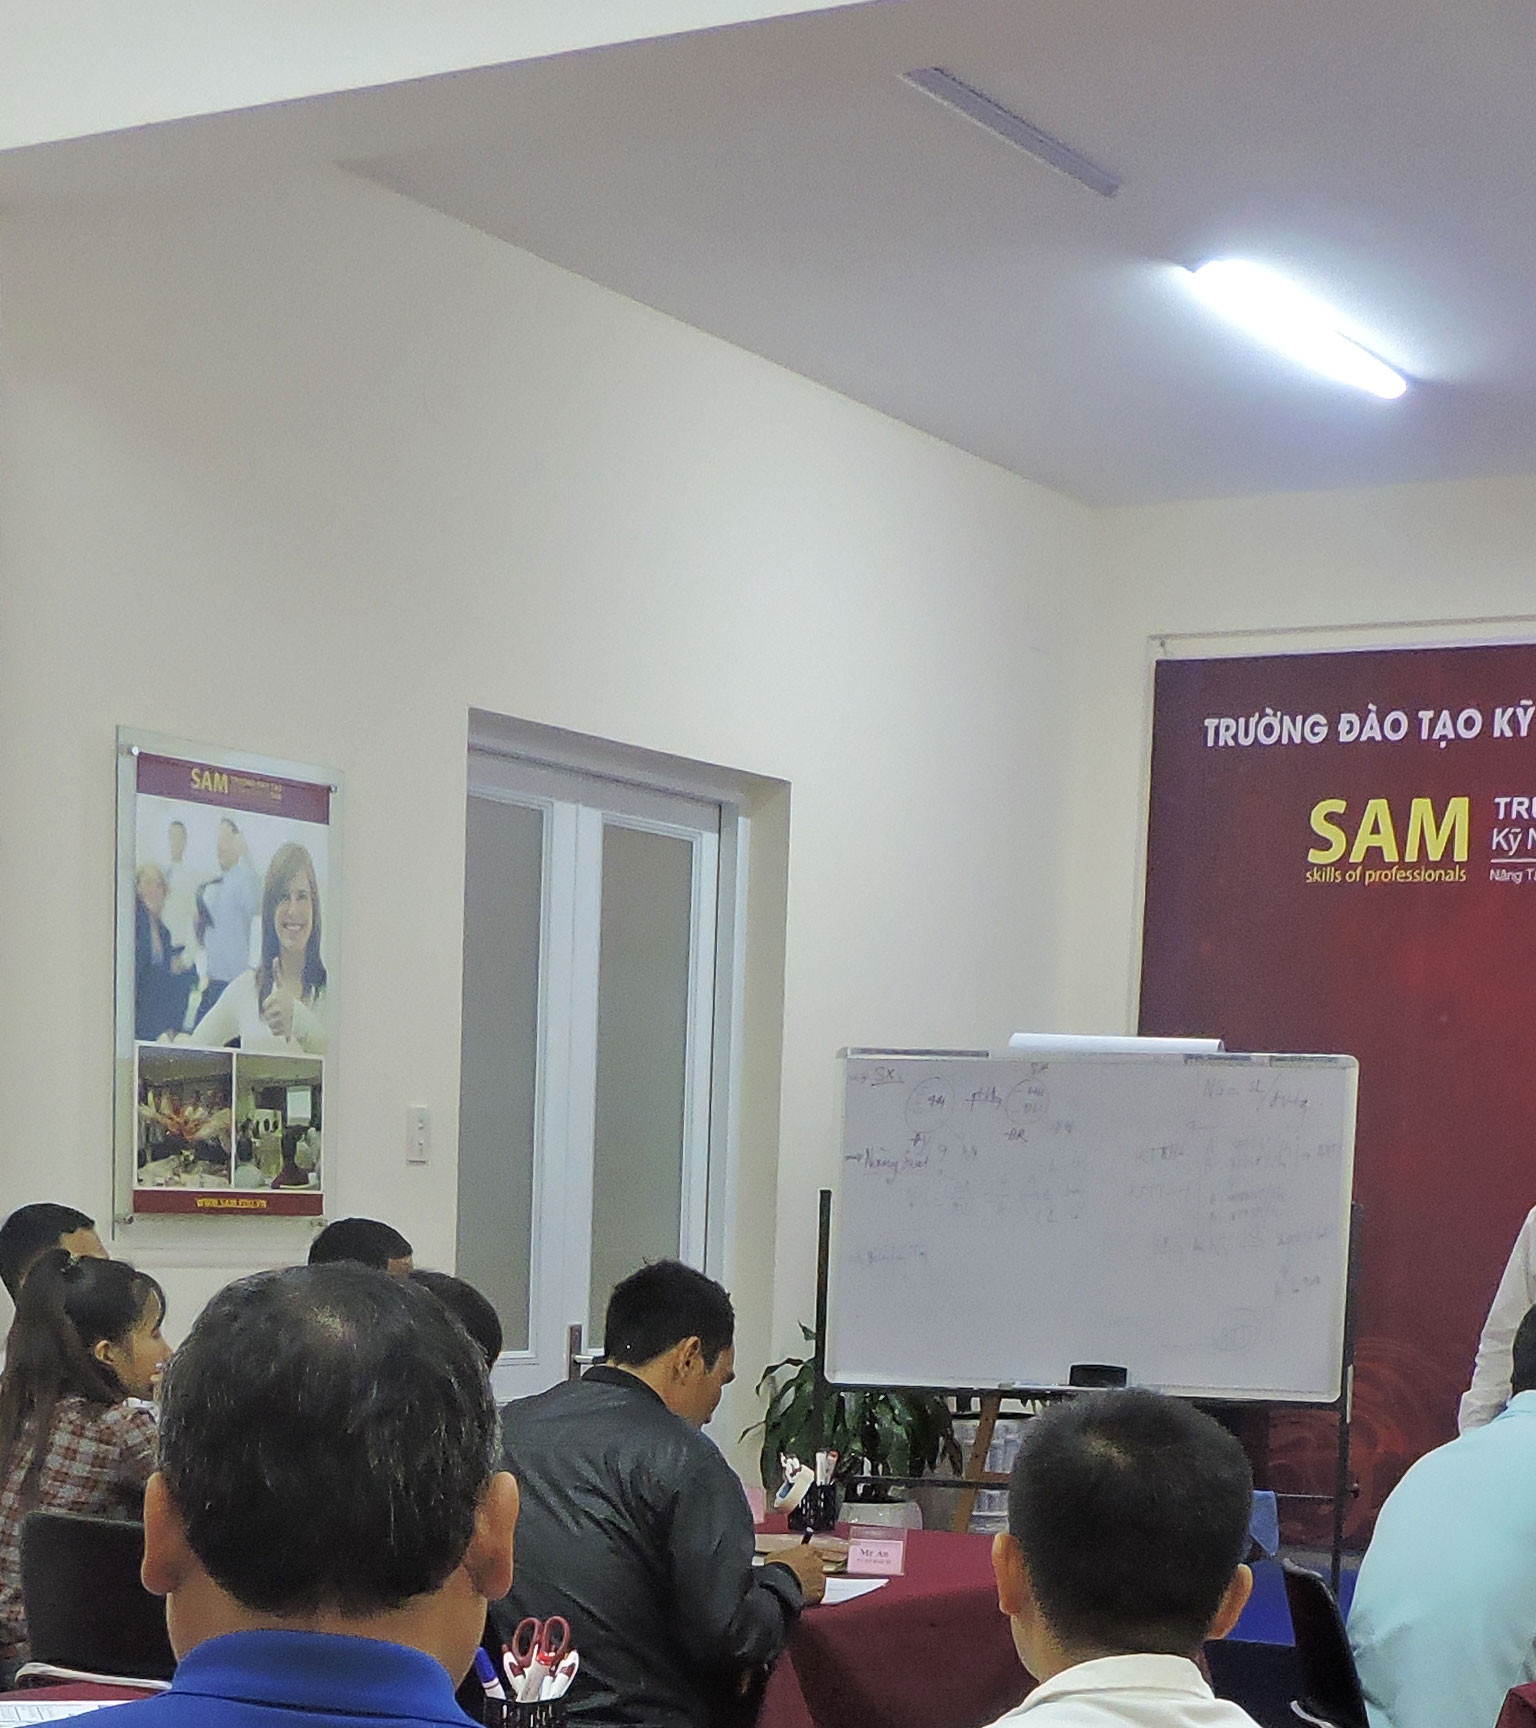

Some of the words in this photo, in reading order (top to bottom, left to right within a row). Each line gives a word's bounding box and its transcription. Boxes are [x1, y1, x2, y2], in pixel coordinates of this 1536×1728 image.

[1204, 707, 1328, 747] TRƯỜNG
[1338, 703, 1408, 742] ĐÀO
[1418, 708, 1483, 748] TẠO
[1493, 699, 1536, 737] KỸ
[191, 768, 229, 794] SAM
[1307, 797, 1470, 864] SAM
[1491, 827, 1523, 856] Kỹ
[1306, 866, 1342, 883] skills
[1345, 866, 1362, 883] of
[1365, 865, 1466, 886] professionals
